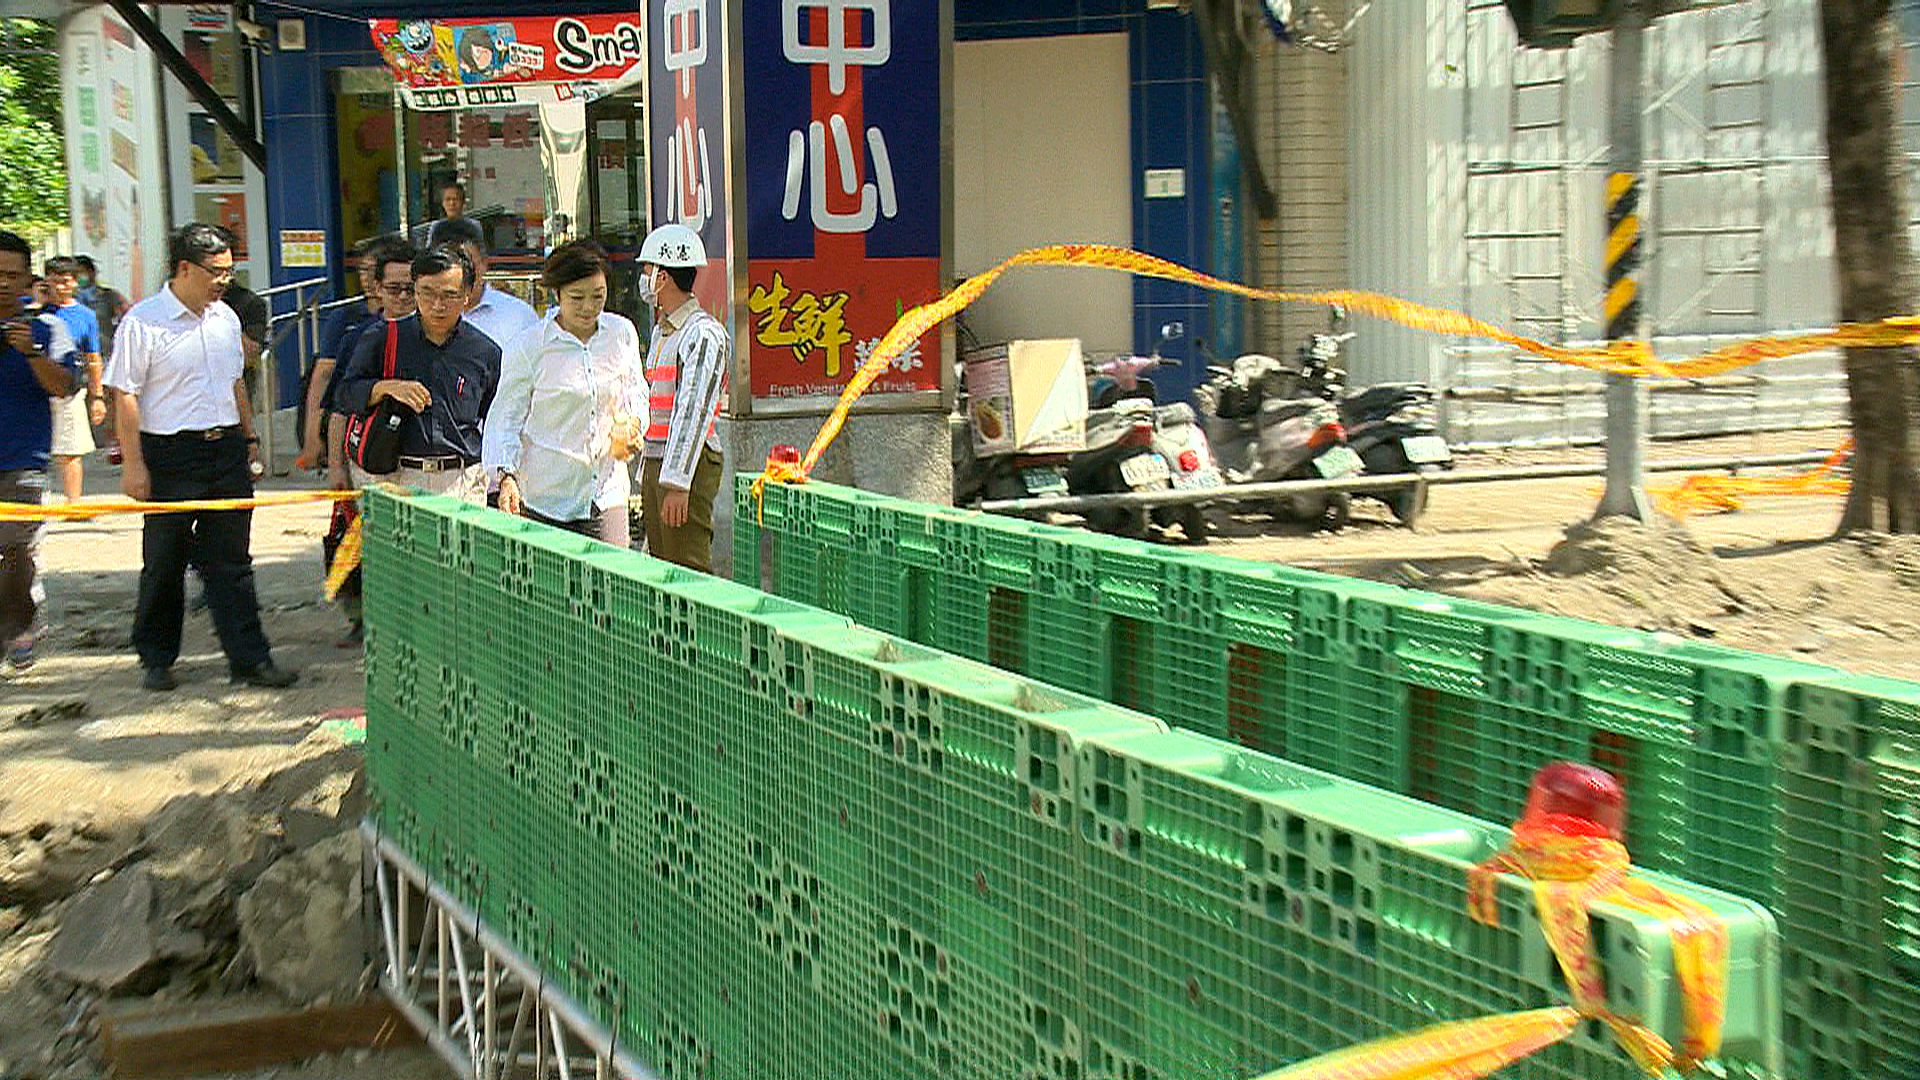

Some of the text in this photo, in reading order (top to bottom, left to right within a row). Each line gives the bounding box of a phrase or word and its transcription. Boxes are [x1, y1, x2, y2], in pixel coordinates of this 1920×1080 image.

[555, 18, 641, 73] Sma
[664, 0, 712, 231] 中心
[781, 0, 898, 234] 中心
[749, 271, 853, 377] 生鮮
[769, 383, 804, 397] Fresh
